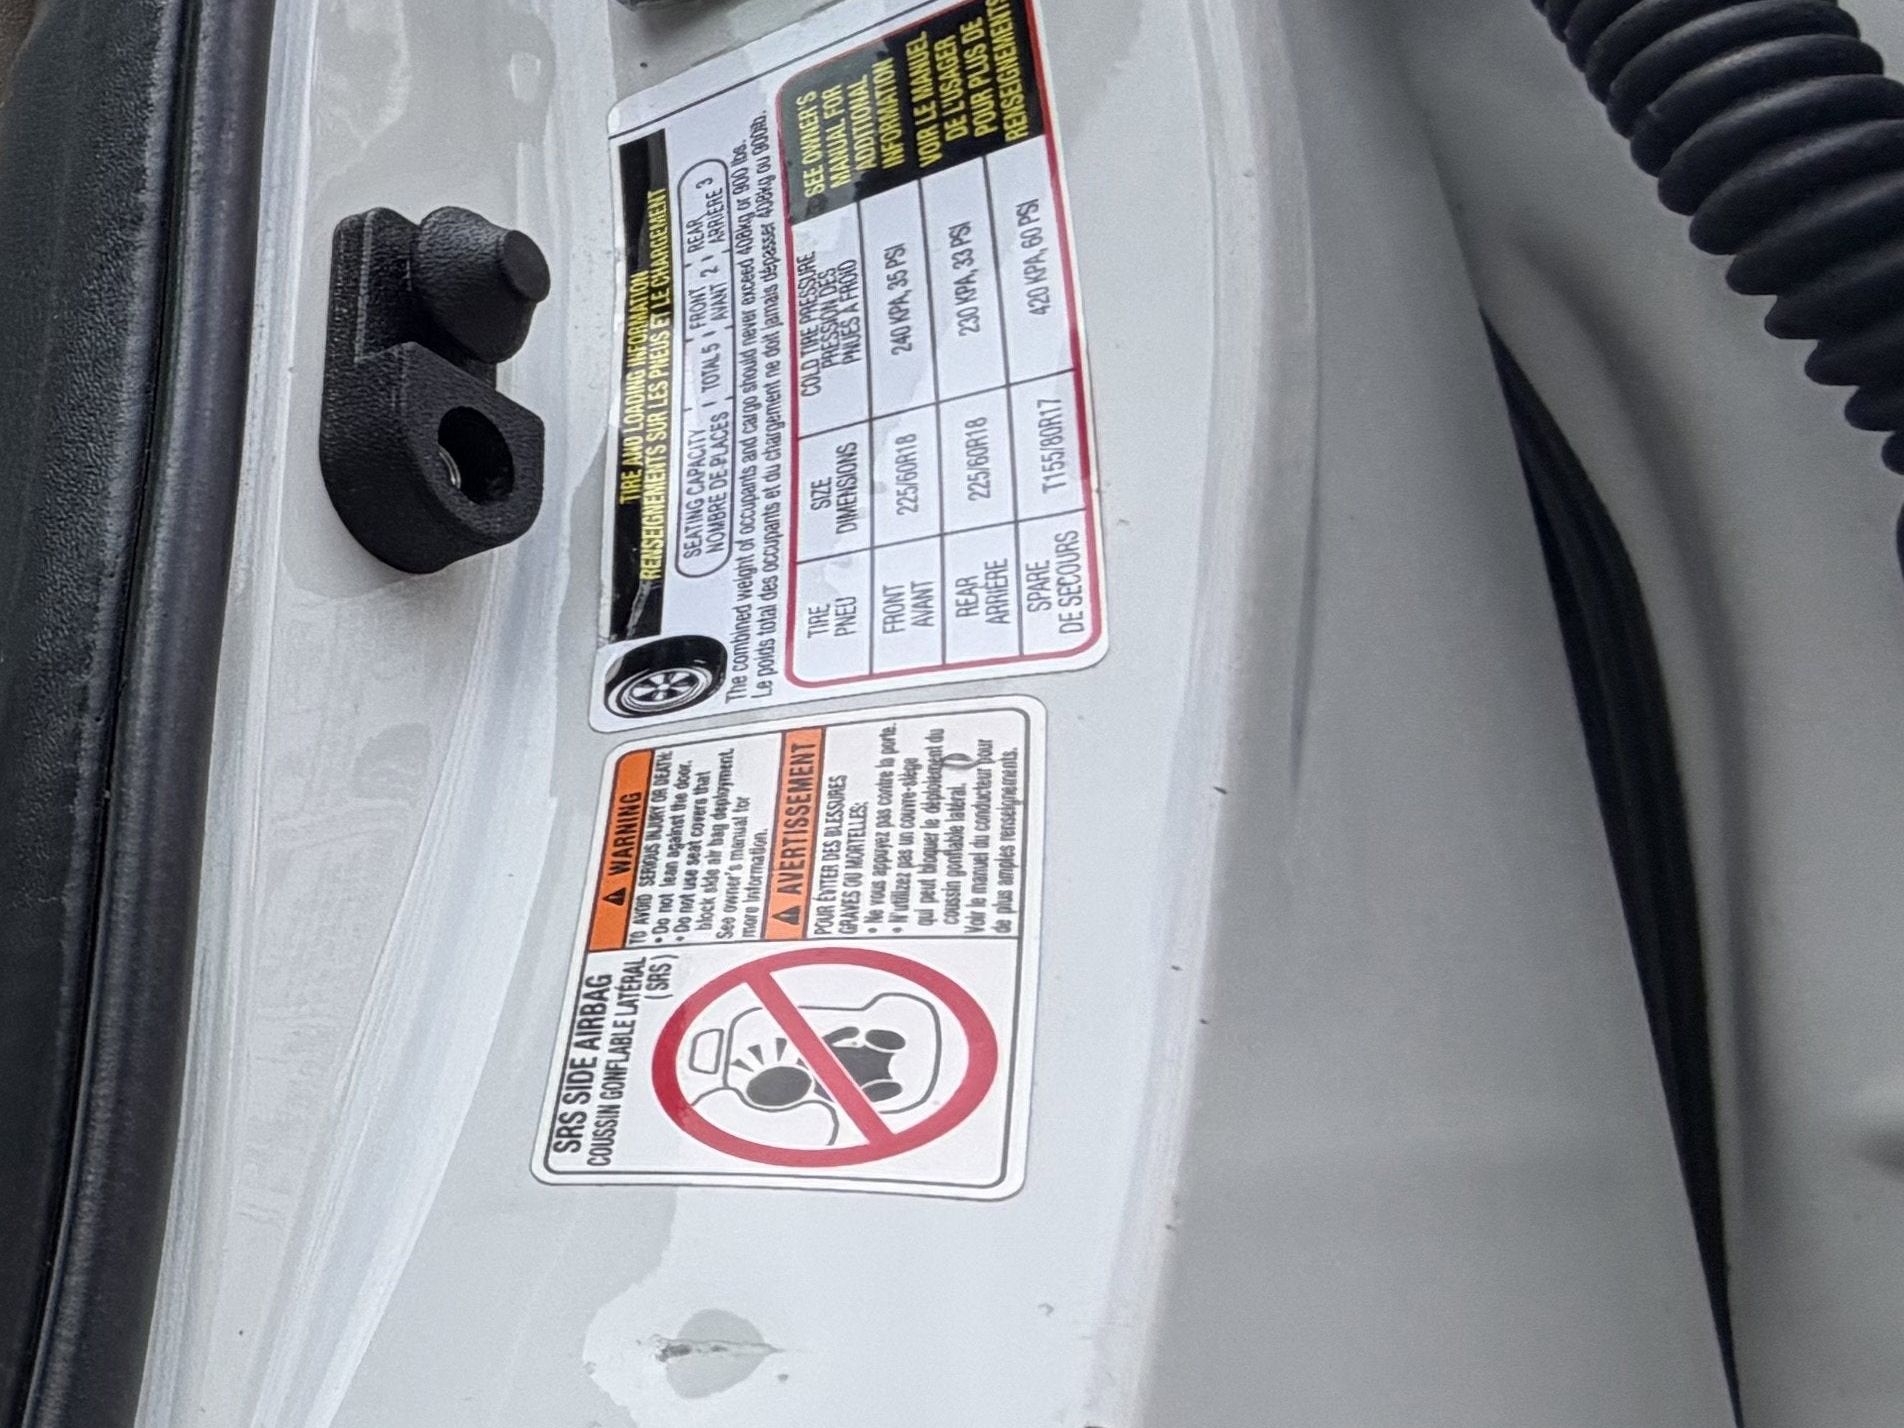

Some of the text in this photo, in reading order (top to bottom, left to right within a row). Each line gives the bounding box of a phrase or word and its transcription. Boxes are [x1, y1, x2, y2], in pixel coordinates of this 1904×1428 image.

[905, 31, 943, 167] VOIR LE MANUEL
[934, 34, 968, 140] DE L'USAGER
[960, 17, 998, 136] POUR PLUS DE
[821, 84, 852, 188] MANUAL FOR
[847, 74, 877, 171] ADDITIONAL
[872, 57, 906, 169] INFORMATION
[756, 156, 771, 173] ou
[796, 91, 825, 197] SEE OWNER'S
[696, 178, 712, 189] 3
[755, 175, 776, 218] 408kg
[686, 216, 704, 253] REAR
[1016, 199, 1050, 315] 420 KPA, 60 PSI
[688, 286, 706, 330] FRONT
[700, 266, 729, 321] AVANT 2
[760, 285, 784, 330] jamais
[837, 259, 857, 301] FROID
[884, 243, 912, 355] 240 KPA, 35 PSI
[948, 221, 980, 336] 230 KPA, 33 PSI
[762, 331, 780, 357] doit
[797, 251, 821, 397] COLD TIRE PRESSURE
[817, 267, 840, 369] PRESSION DES
[620, 270, 649, 504] TIRE AND LOADING INFORMATION
[640, 188, 670, 580] RENSEIGNEMENTS SUR LES PNEUS ET LE CHARGEMENT
[701, 343, 720, 393] TOTAL 5
[764, 360, 781, 378] ne
[709, 412, 729, 467] PLACES
[725, 140, 762, 703] The combined weight of occupants and cargo should never exceed 408kg or 900 lbs.
[762, 380, 785, 461] chargement
[1037, 399, 1066, 493] T155/80R17
[761, 464, 781, 482] du
[836, 442, 858, 534] DIMENSIONS
[894, 434, 919, 515] 225/60R18
[965, 417, 991, 501] 225/60R18
[683, 430, 706, 559] SEATING CAPACITY
[762, 484, 781, 498] et
[811, 477, 832, 511] SIZE
[705, 494, 726, 553] NOMBRE
[761, 502, 783, 572] occupants
[757, 575, 778, 600] des
[882, 585, 905, 634] FRONT
[911, 581, 935, 627] AVANT
[955, 576, 980, 618] REAR
[1026, 560, 1052, 612] SPARE
[1054, 531, 1085, 633] DE SECOURS
[757, 604, 777, 635] total
[807, 604, 831, 638] TIRE
[834, 597, 857, 636] PNEU
[754, 638, 778, 676] poids
[751, 680, 773, 698] Le
[608, 792, 641, 875] WARNING
[777, 744, 816, 895] AVERTISSEMENT
[863, 723, 900, 923] Ne vous appuyez pas contre la porte.
[673, 771, 711, 932] Do not use seat covers that
[821, 840, 842, 861] DES
[843, 873, 862, 887] OU
[814, 905, 836, 934] POUR
[838, 891, 861, 934] GRAVES
[552, 974, 612, 1153] SRS SIDE AIRBAG
[587, 957, 646, 1166] COUSSIN GONFLABLE LATÉRAL
